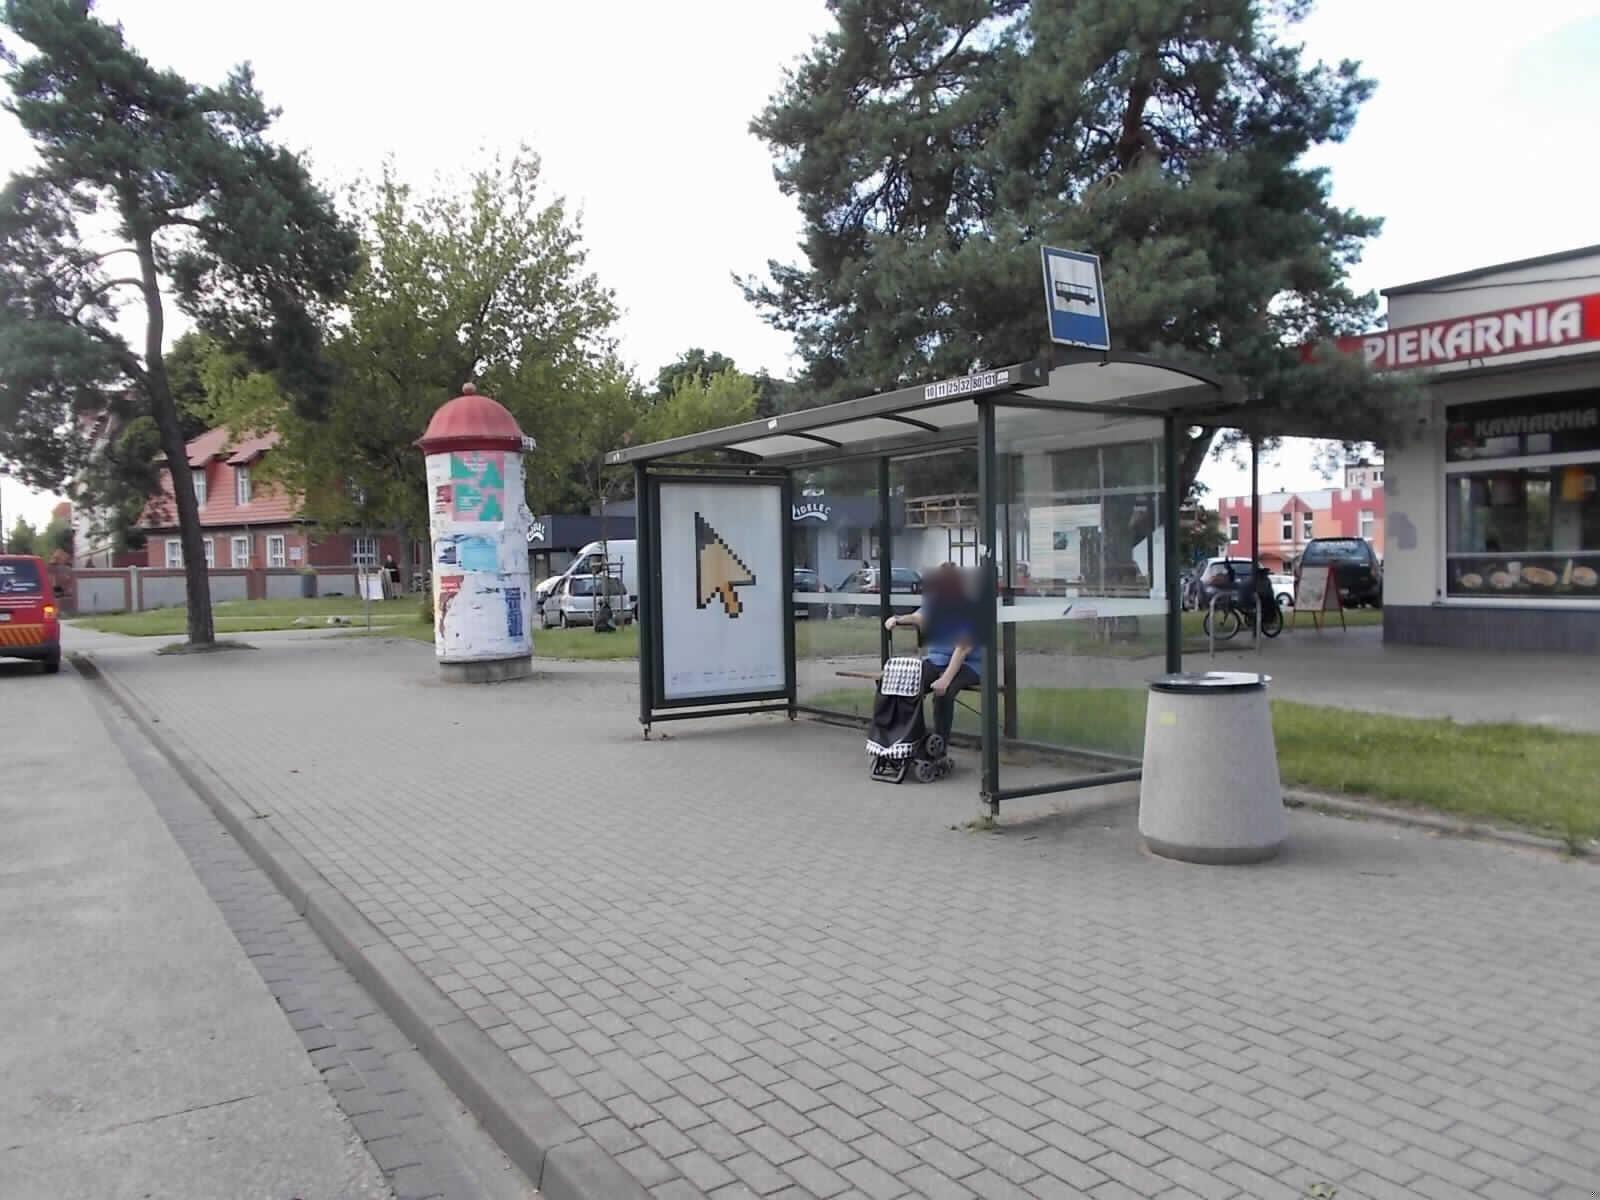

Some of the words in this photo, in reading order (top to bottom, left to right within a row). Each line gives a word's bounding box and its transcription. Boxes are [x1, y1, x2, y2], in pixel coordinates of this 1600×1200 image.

[1362, 302, 1582, 367] PIEKARNIA
[938, 384, 945, 396] 11
[960, 379, 970, 391] 32
[1473, 408, 1599, 438] KAWIARNIA
